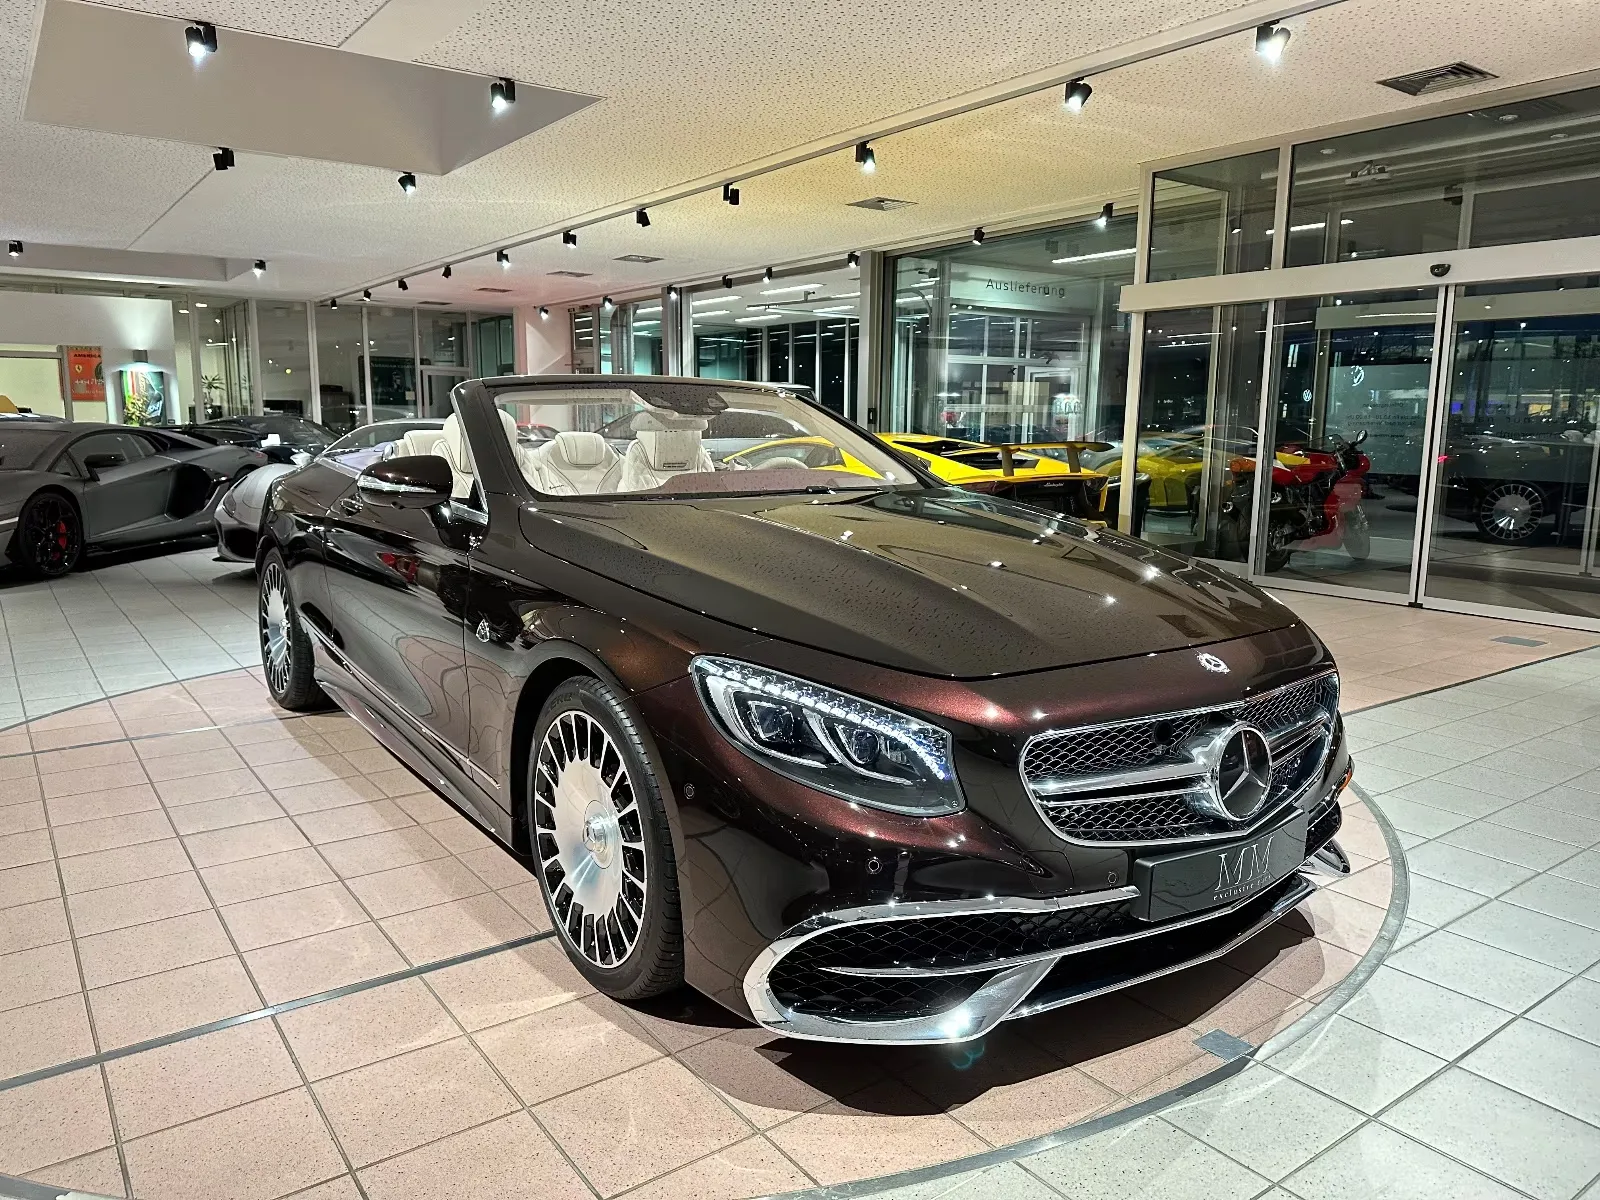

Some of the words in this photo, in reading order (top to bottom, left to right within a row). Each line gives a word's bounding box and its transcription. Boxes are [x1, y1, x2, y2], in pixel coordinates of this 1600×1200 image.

[986, 278, 1065, 298] Auslieferung
[1214, 836, 1274, 890] MM
[1213, 883, 1254, 901] exclusive
